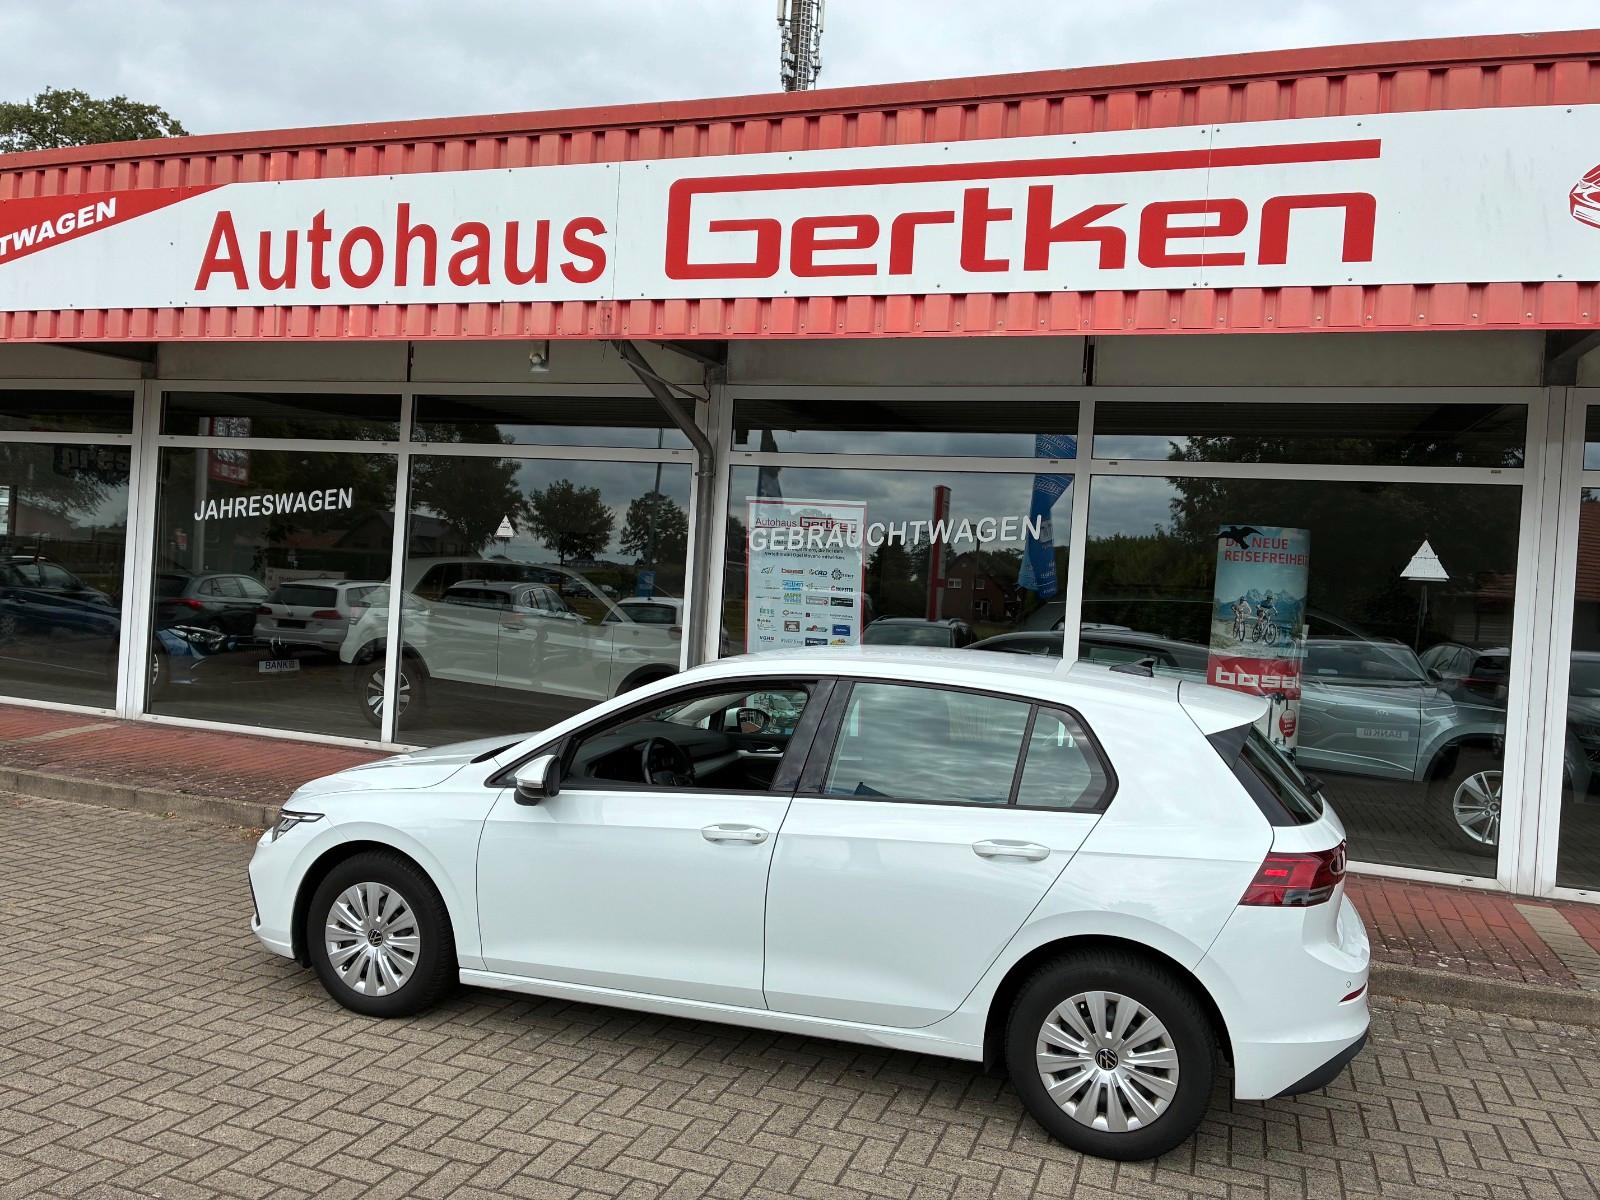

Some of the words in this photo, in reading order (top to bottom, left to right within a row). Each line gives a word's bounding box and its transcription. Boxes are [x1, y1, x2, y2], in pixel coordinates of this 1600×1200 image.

[0, 197, 117, 256] TWAGEN
[194, 202, 608, 291] Autohaus
[665, 138, 1382, 280] Gertken
[194, 487, 353, 522] JAHRESWAGEN
[755, 517, 797, 527] Autohaus
[748, 514, 1042, 552] GEBRAUCHTWAGEN
[1252, 537, 1289, 549] NEUE
